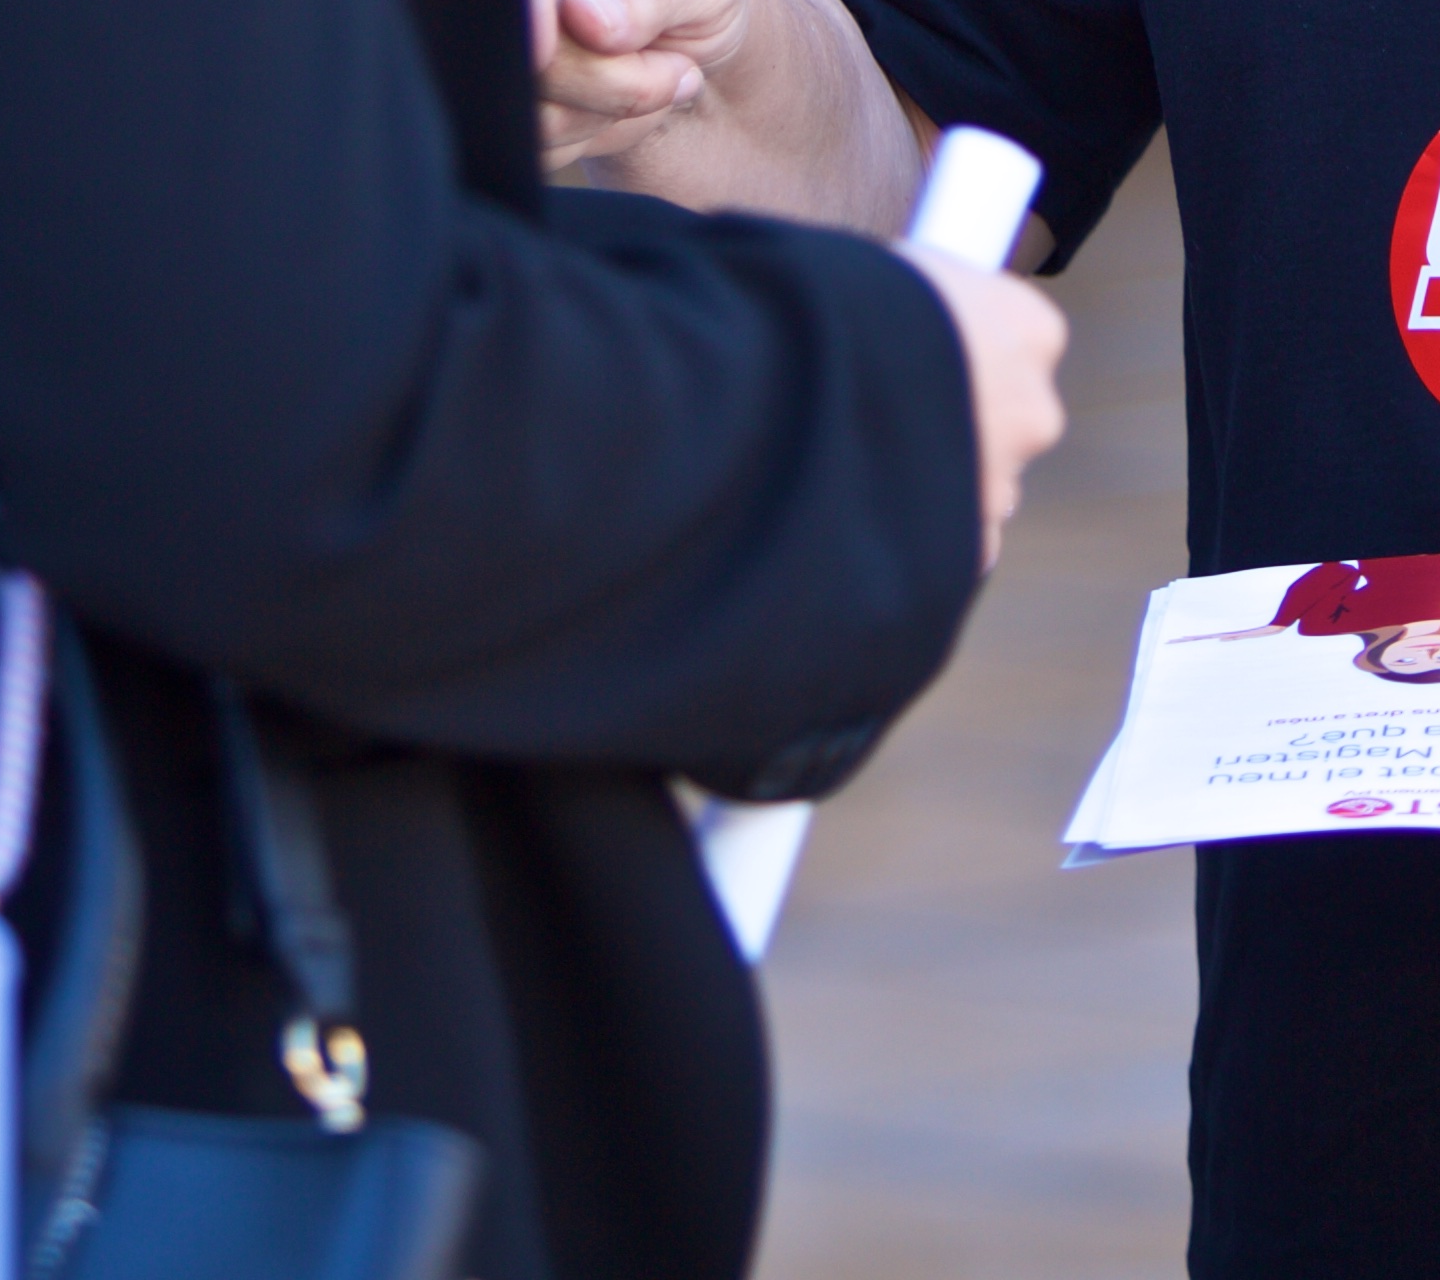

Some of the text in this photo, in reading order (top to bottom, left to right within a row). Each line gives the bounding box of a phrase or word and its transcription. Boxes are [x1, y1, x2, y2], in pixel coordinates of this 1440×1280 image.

[1354, 710, 1403, 719] dret
[1288, 724, 1406, 746] què?
[1213, 744, 1433, 768] Magisteri
[1207, 770, 1309, 786] meu
[1326, 768, 1364, 782] el
